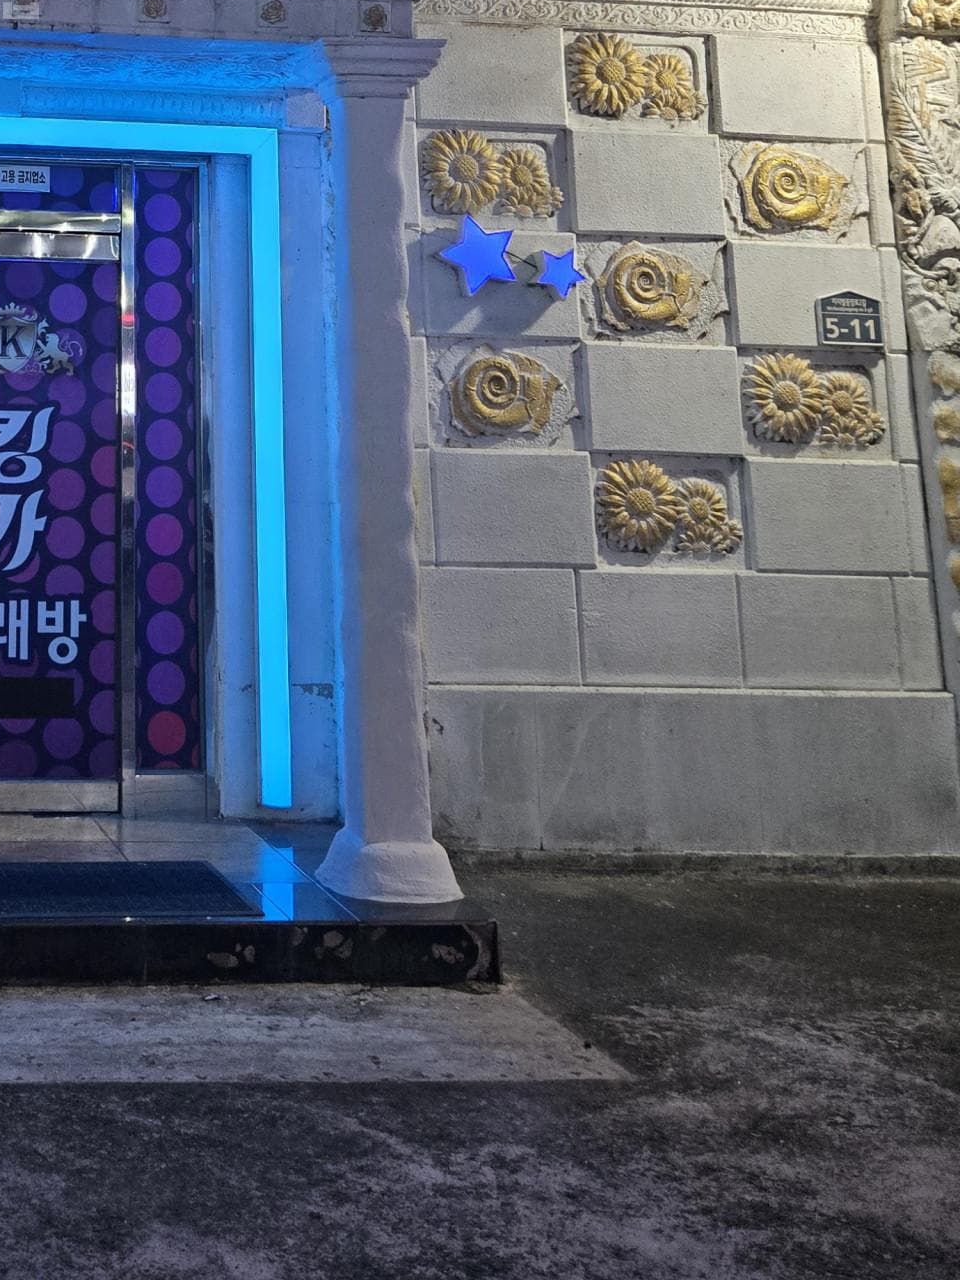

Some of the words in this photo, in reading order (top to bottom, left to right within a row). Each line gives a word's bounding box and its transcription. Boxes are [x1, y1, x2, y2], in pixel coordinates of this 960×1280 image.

[18, 171, 46, 185] 금지업소
[825, 317, 876, 340] 5-11
[0, 325, 29, 360] K
